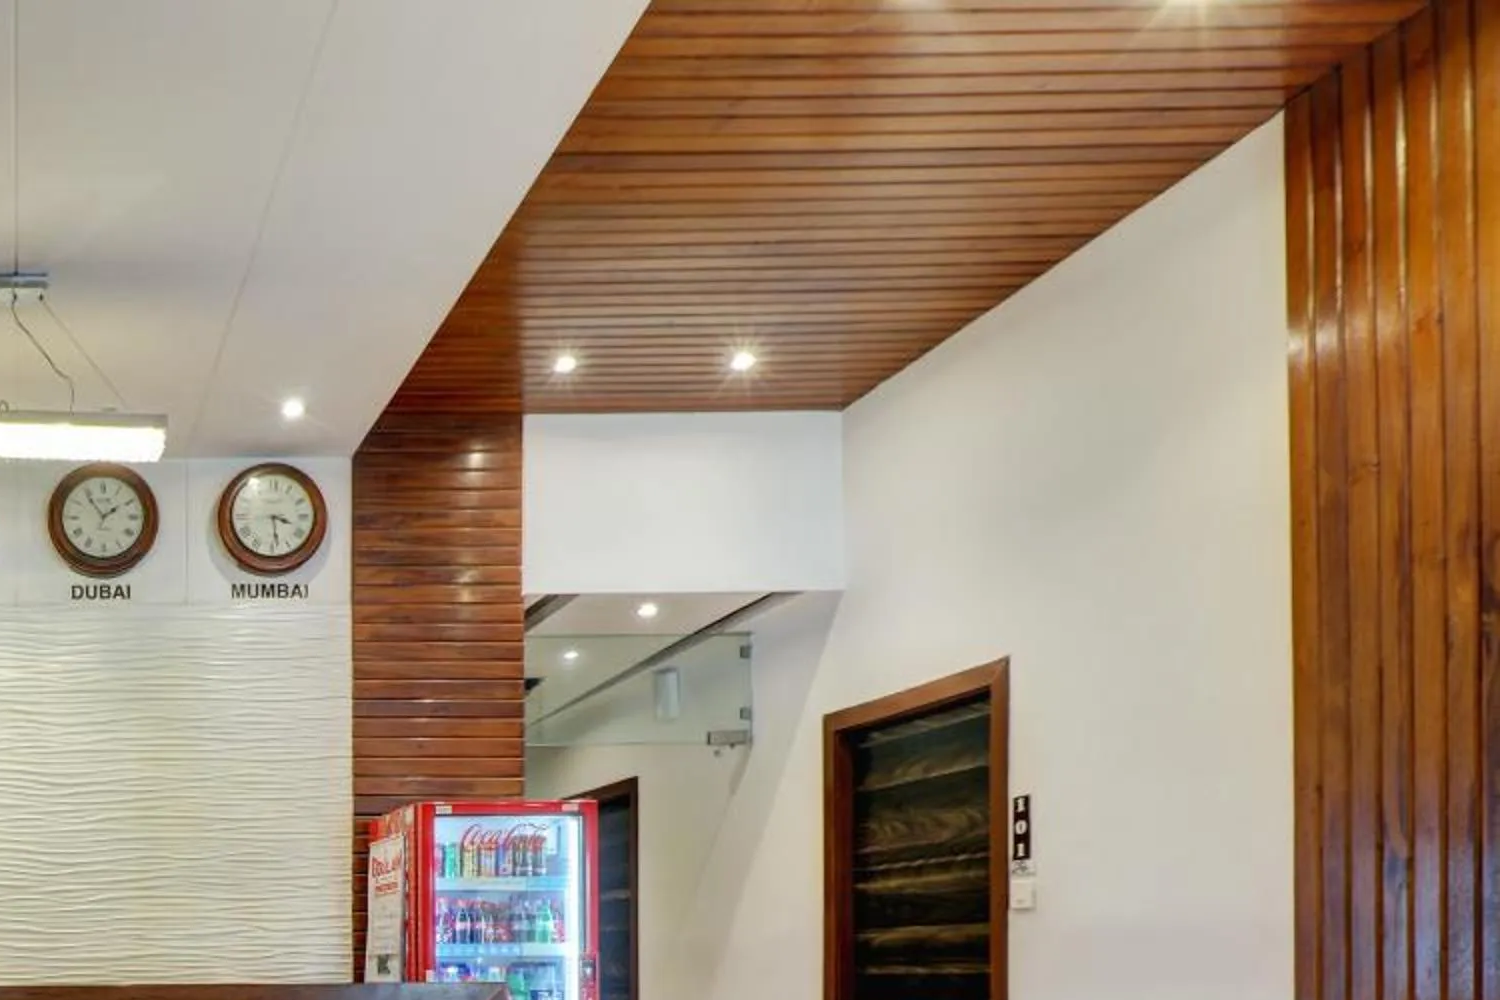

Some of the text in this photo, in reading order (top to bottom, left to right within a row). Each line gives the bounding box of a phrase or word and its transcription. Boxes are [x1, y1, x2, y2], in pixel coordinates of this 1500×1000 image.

[70, 584, 132, 600] DUBAI
[230, 583, 309, 599] MUMBAI
[1015, 797, 1028, 858] 101
